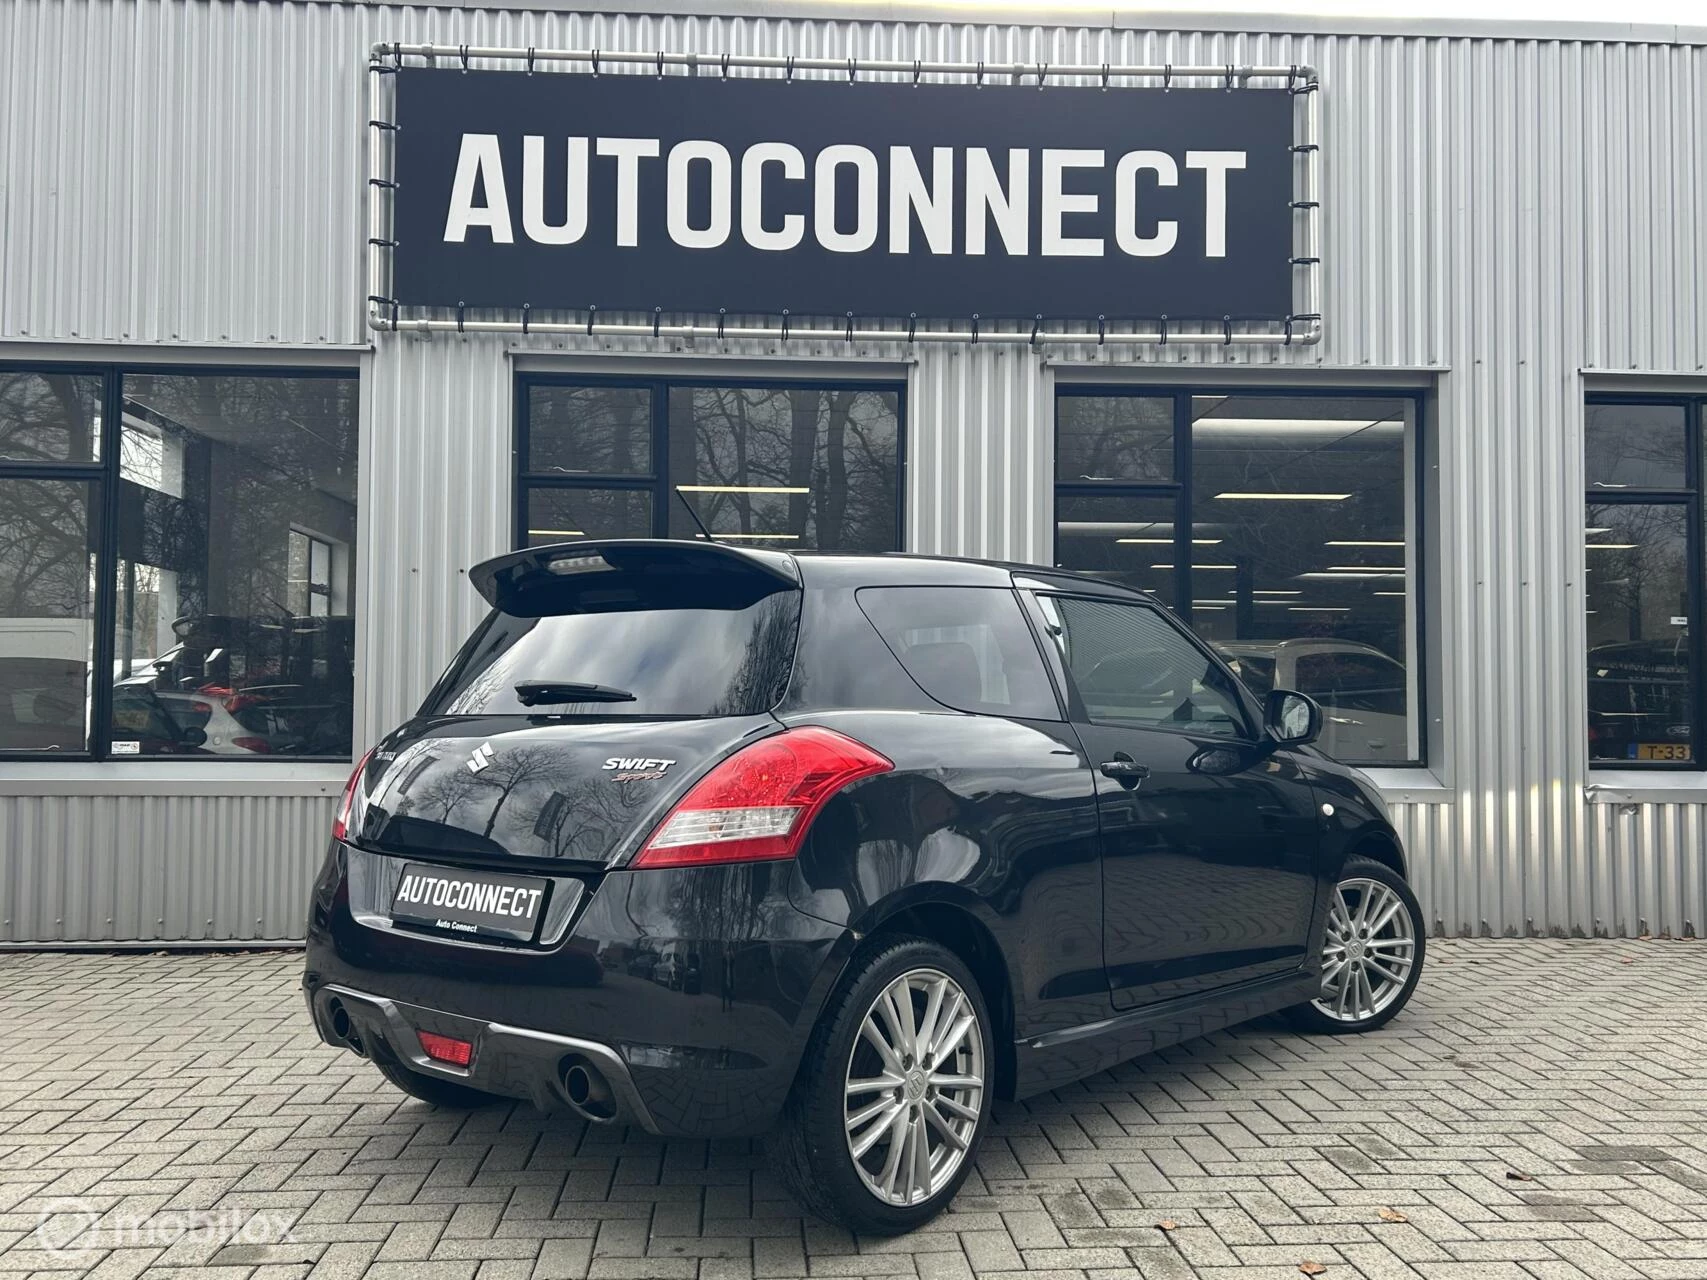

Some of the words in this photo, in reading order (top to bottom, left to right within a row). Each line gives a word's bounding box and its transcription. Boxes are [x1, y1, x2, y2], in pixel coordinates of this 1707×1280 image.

[443, 133, 1247, 258] AUTOCONNECT
[602, 757, 677, 772] SWIFT
[397, 875, 542, 919] AUTOCONNECT
[435, 918, 451, 930] Auto
[451, 920, 478, 933] Connect
